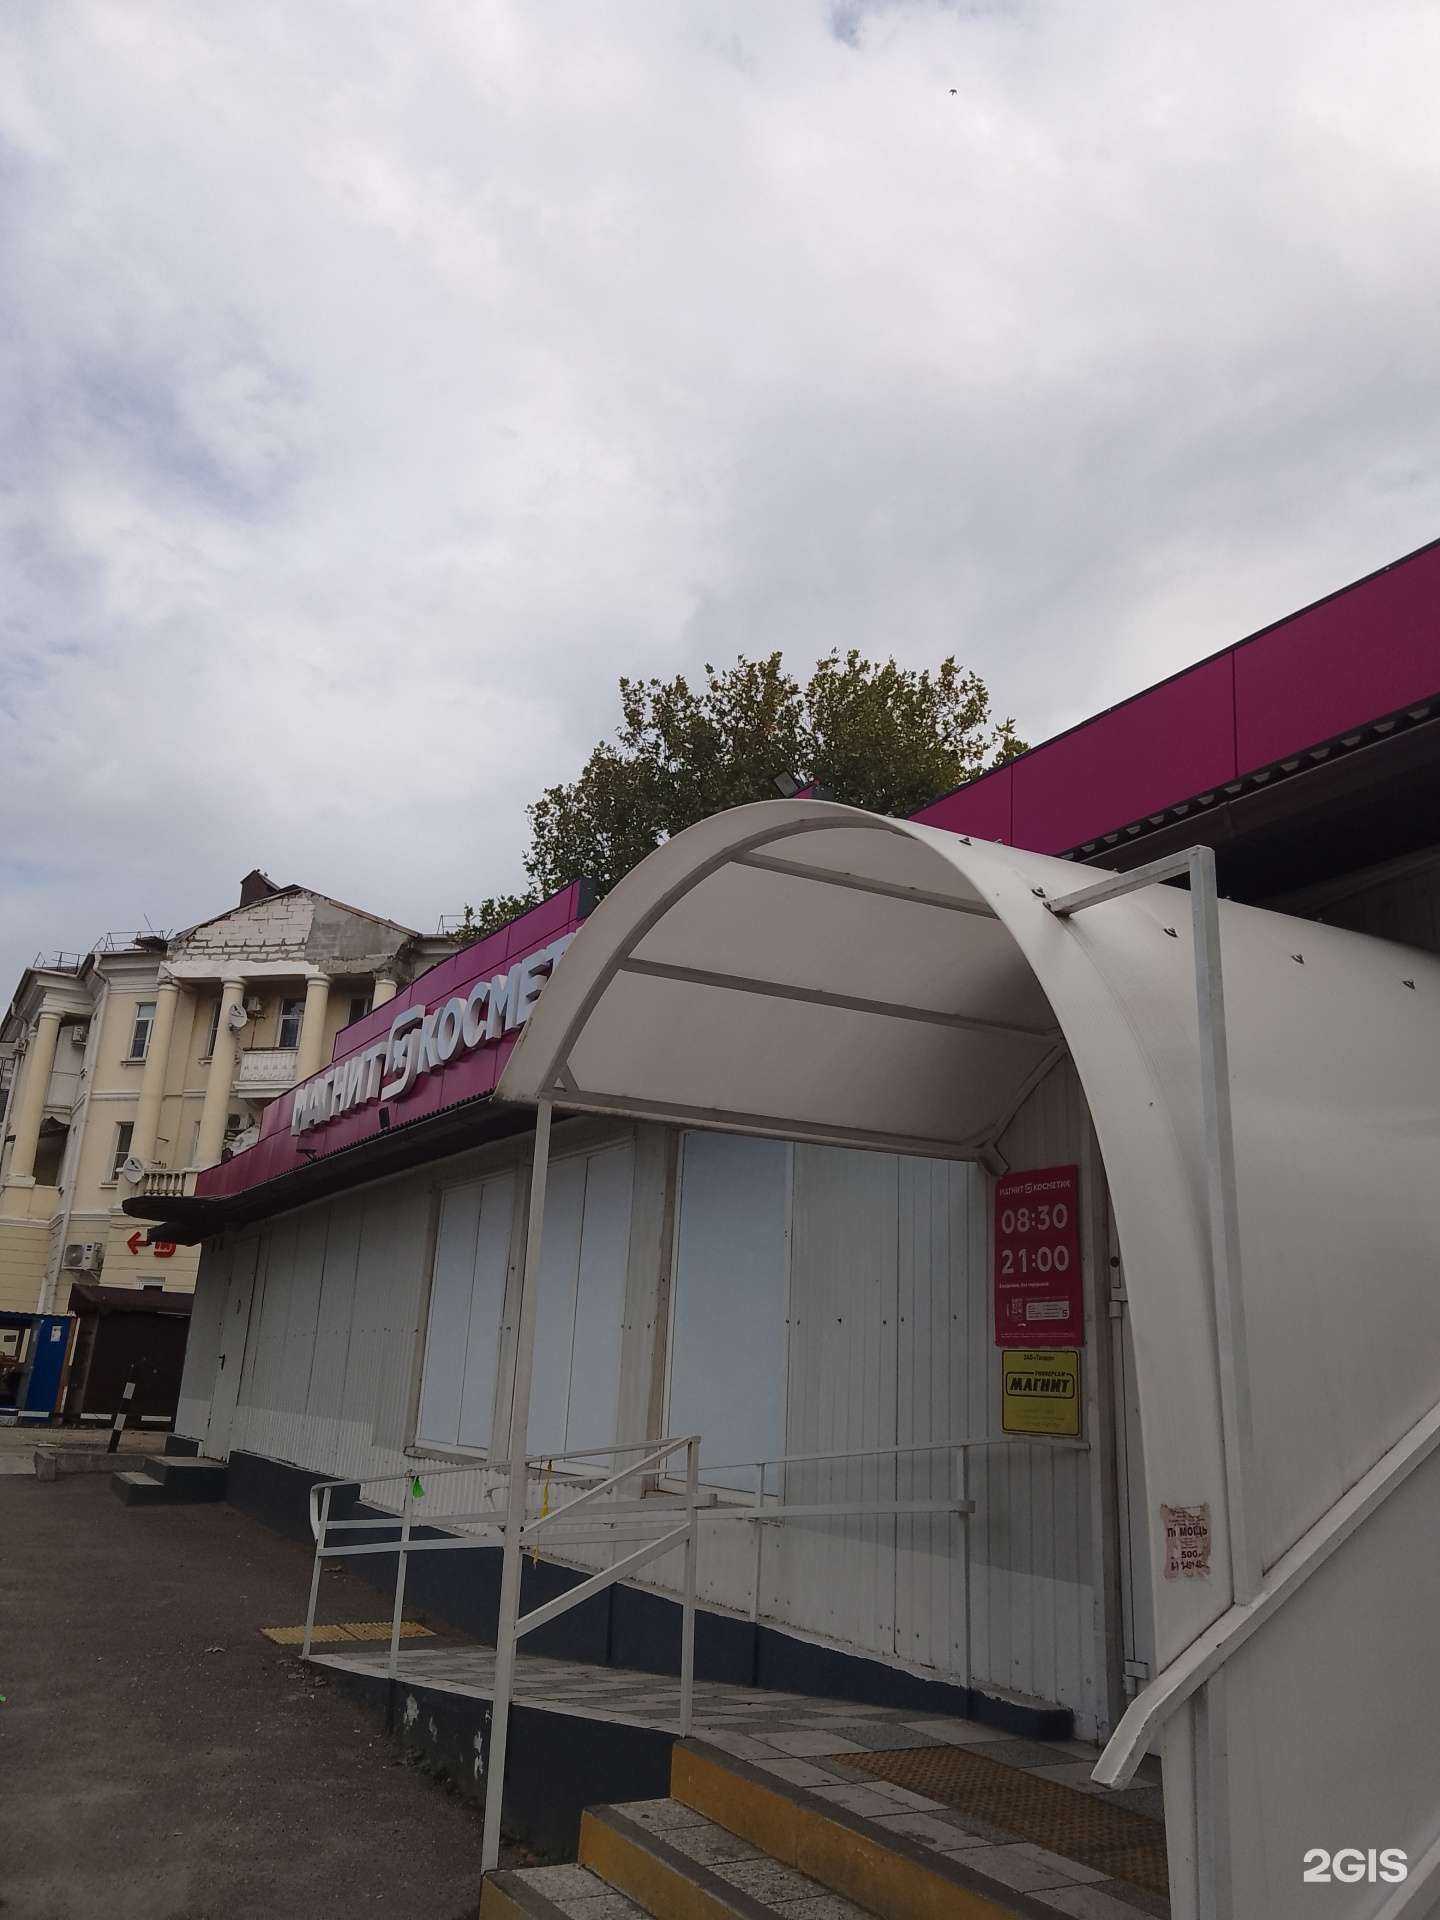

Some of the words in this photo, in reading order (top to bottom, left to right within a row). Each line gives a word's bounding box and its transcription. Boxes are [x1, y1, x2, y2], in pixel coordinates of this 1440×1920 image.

[290, 1042, 387, 1136] МАГНИТ
[1001, 1202, 1068, 1234] 08:30
[1001, 1245, 1070, 1274] 21:00
[1010, 1377, 1070, 1393] МАГНИТ
